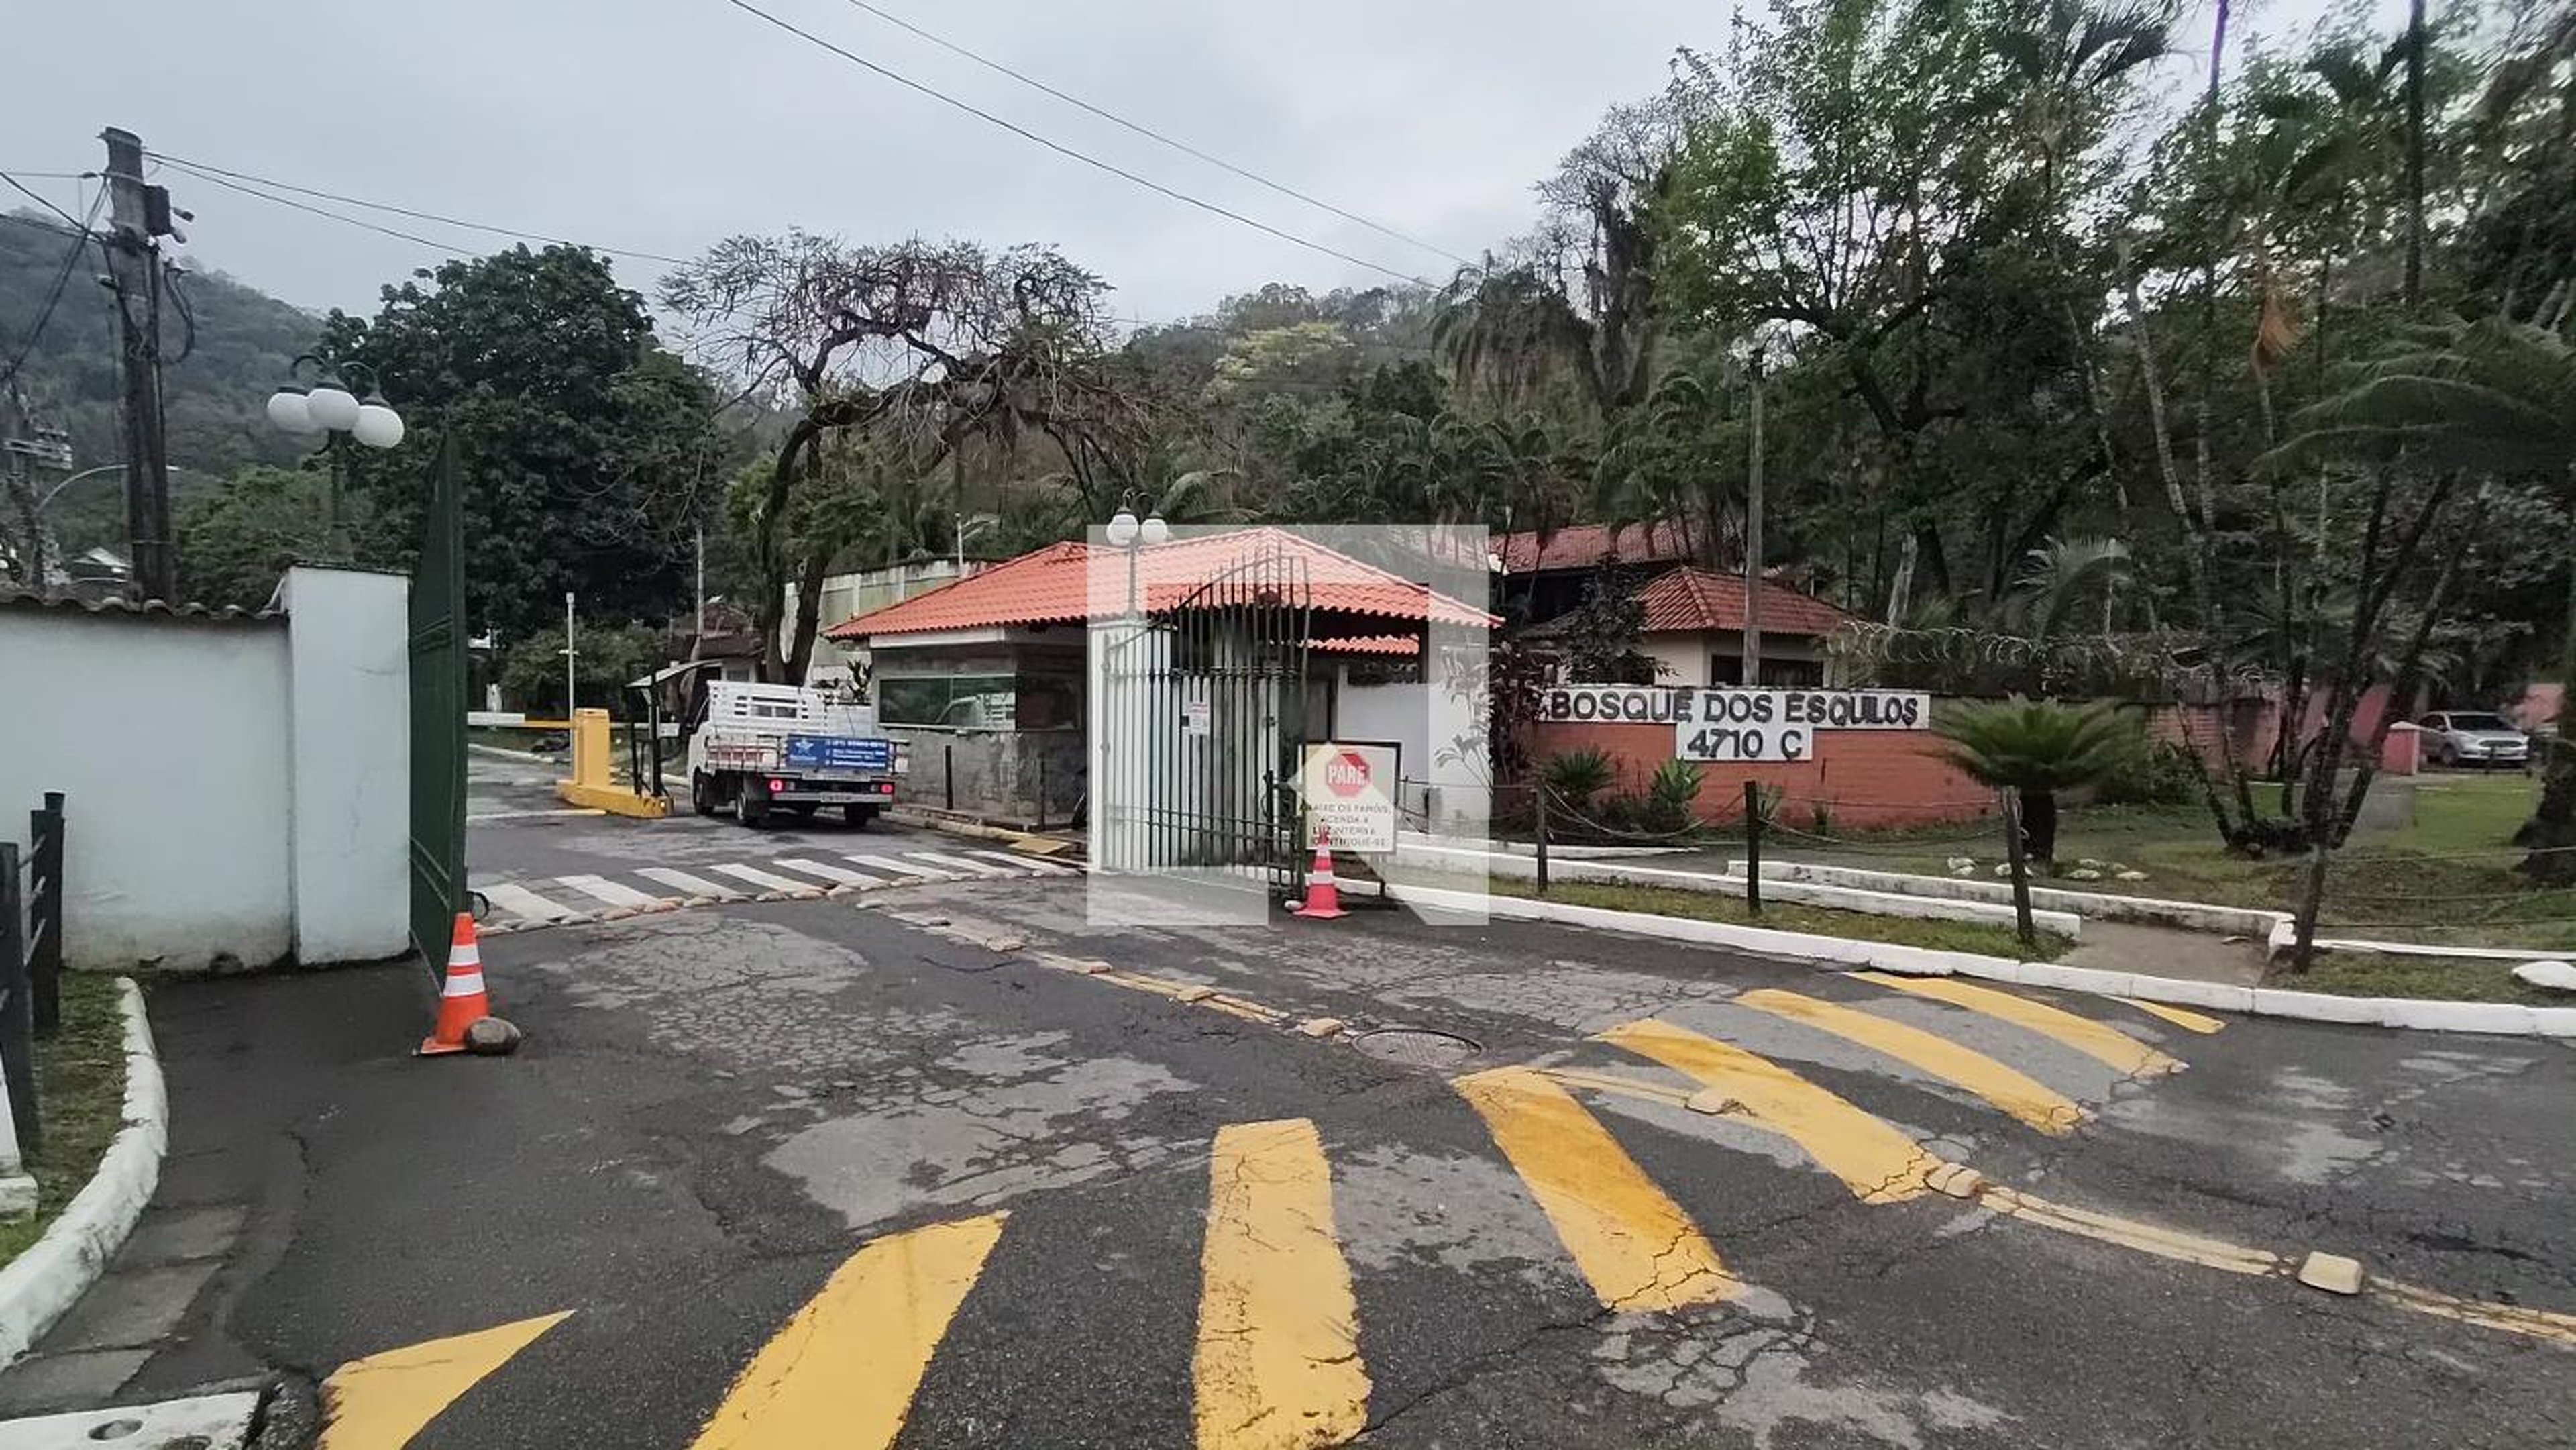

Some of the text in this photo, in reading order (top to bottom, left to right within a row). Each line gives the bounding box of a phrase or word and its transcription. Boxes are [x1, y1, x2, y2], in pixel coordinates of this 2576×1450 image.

[1550, 688, 1918, 727] BOSQUE DOS ESQUILOS
[1687, 728, 1803, 760] 4710 C
[1328, 764, 1367, 784] PARE
